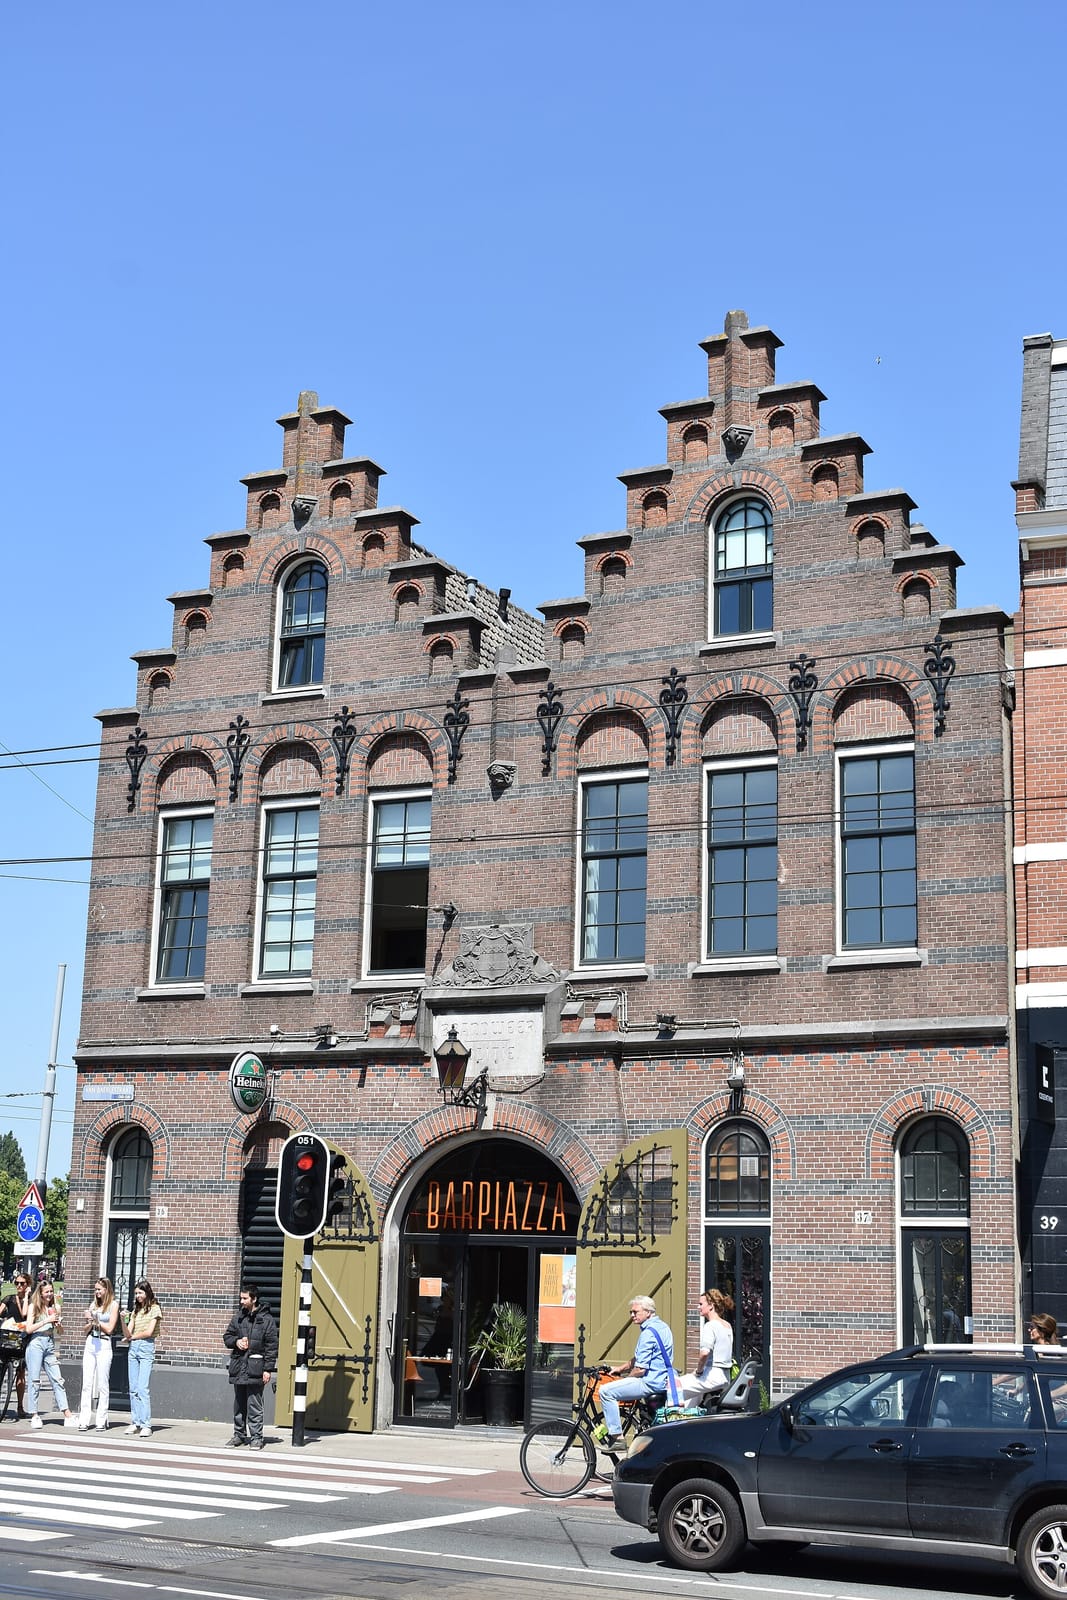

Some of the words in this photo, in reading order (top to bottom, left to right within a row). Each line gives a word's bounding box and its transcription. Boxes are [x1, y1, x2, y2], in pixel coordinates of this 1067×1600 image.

[297, 1136, 314, 1145] 051
[427, 1181, 567, 1232] BARPIAZZA
[1040, 1216, 1058, 1230] 39
